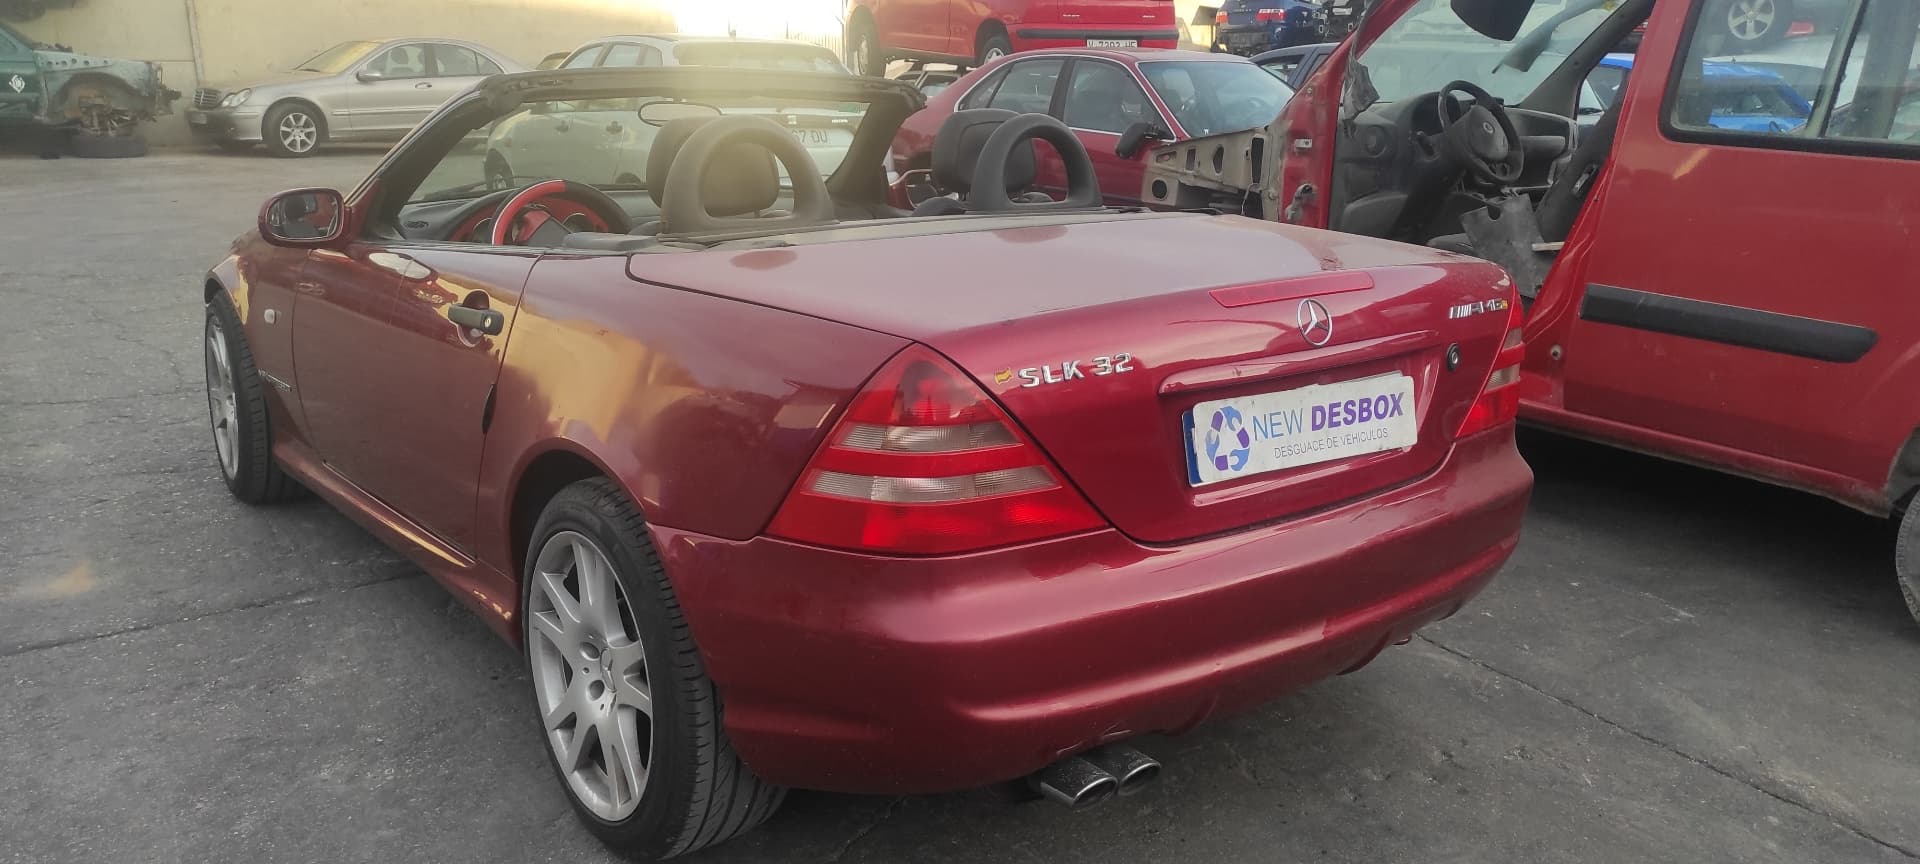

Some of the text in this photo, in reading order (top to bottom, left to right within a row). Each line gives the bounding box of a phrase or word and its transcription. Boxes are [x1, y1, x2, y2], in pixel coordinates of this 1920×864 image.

[1019, 352, 1133, 388] SLK 32
[1252, 392, 1405, 441] NEW DESBOX
[1274, 428, 1389, 459] DESGUACE DE VEHICULOS
